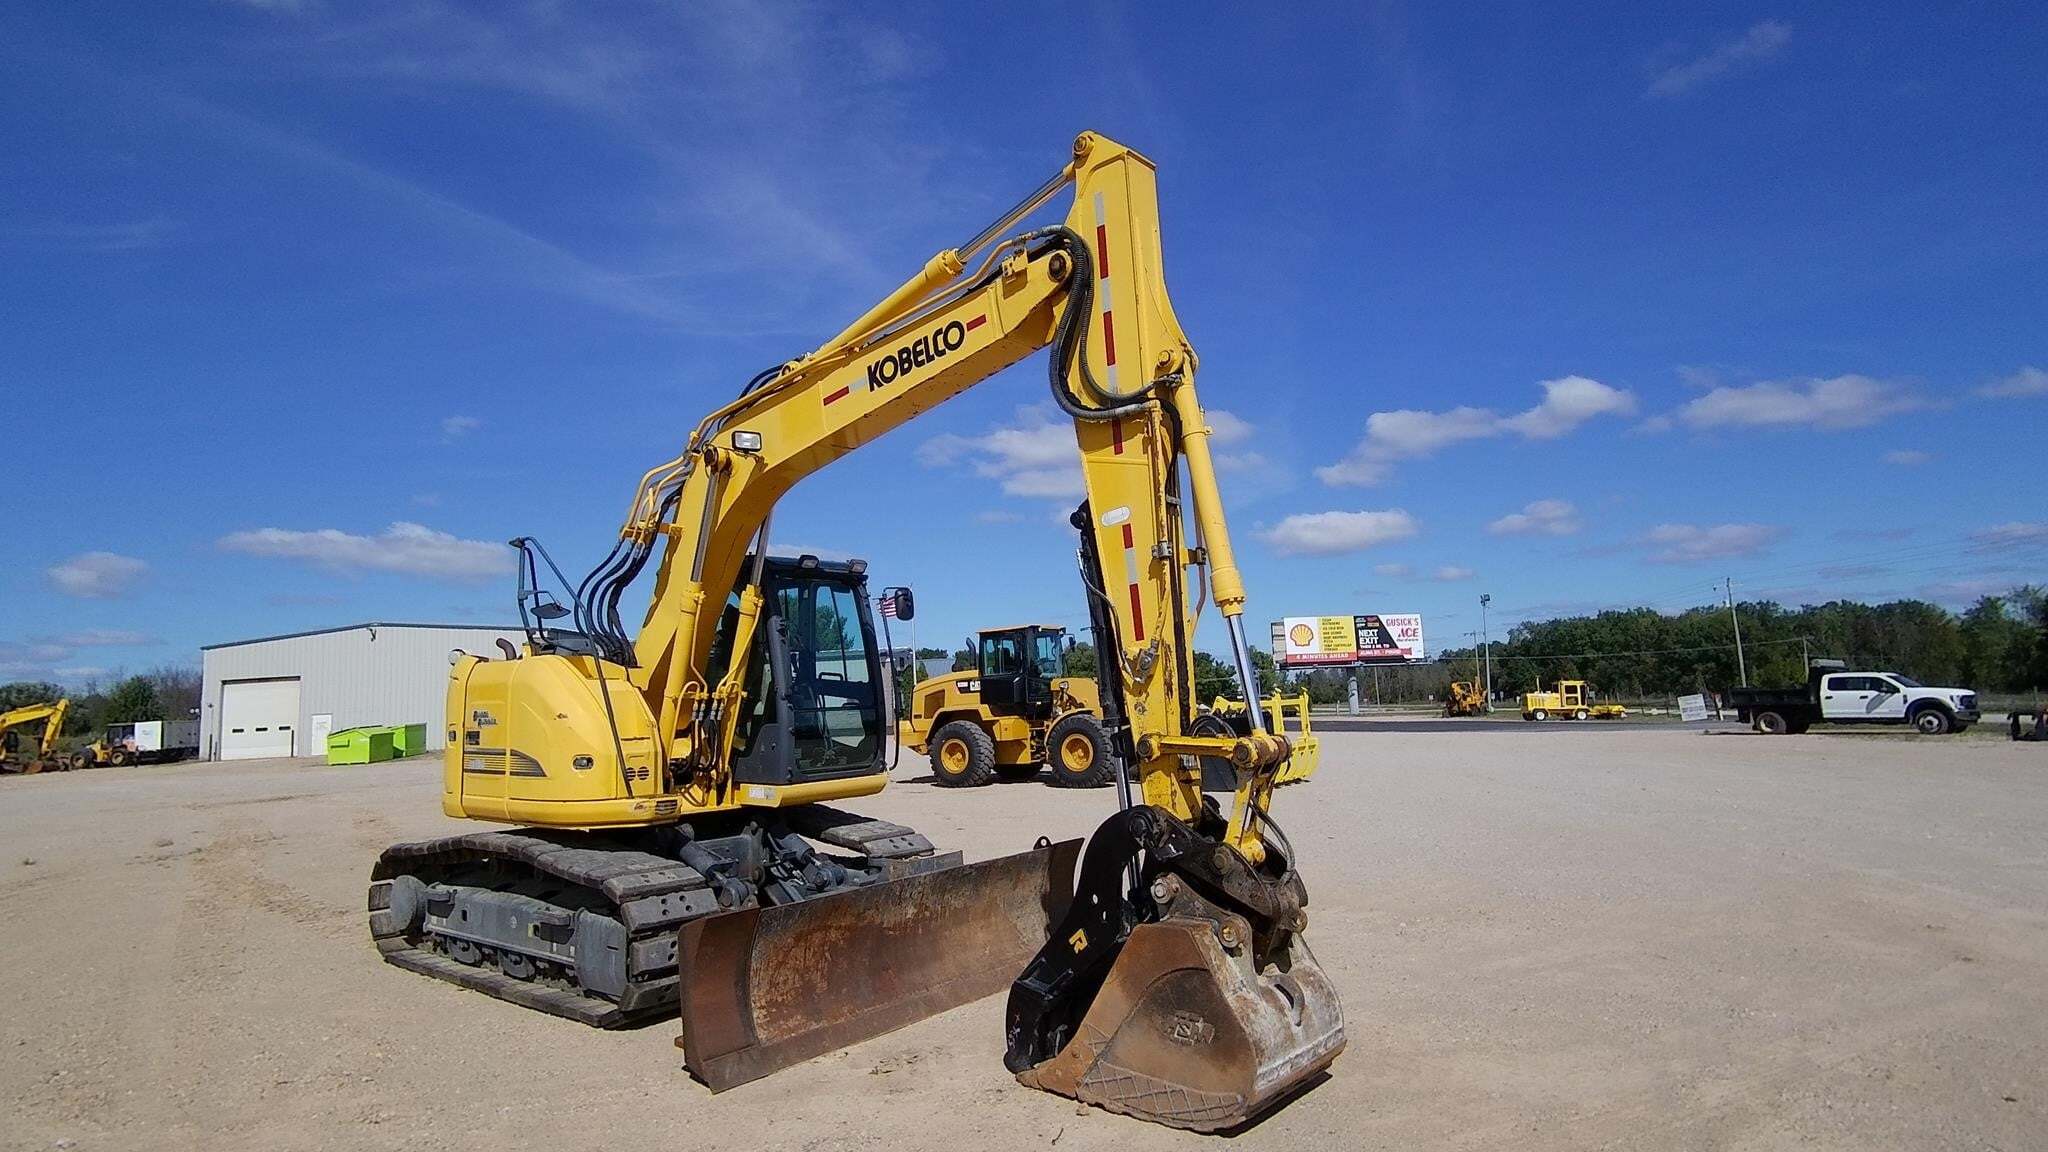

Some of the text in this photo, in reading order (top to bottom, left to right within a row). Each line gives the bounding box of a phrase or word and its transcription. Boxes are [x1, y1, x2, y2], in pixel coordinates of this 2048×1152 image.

[867, 320, 965, 392] KOBELCO
[1358, 629, 1378, 637] NEXT
[1398, 628, 1419, 638] ACE
